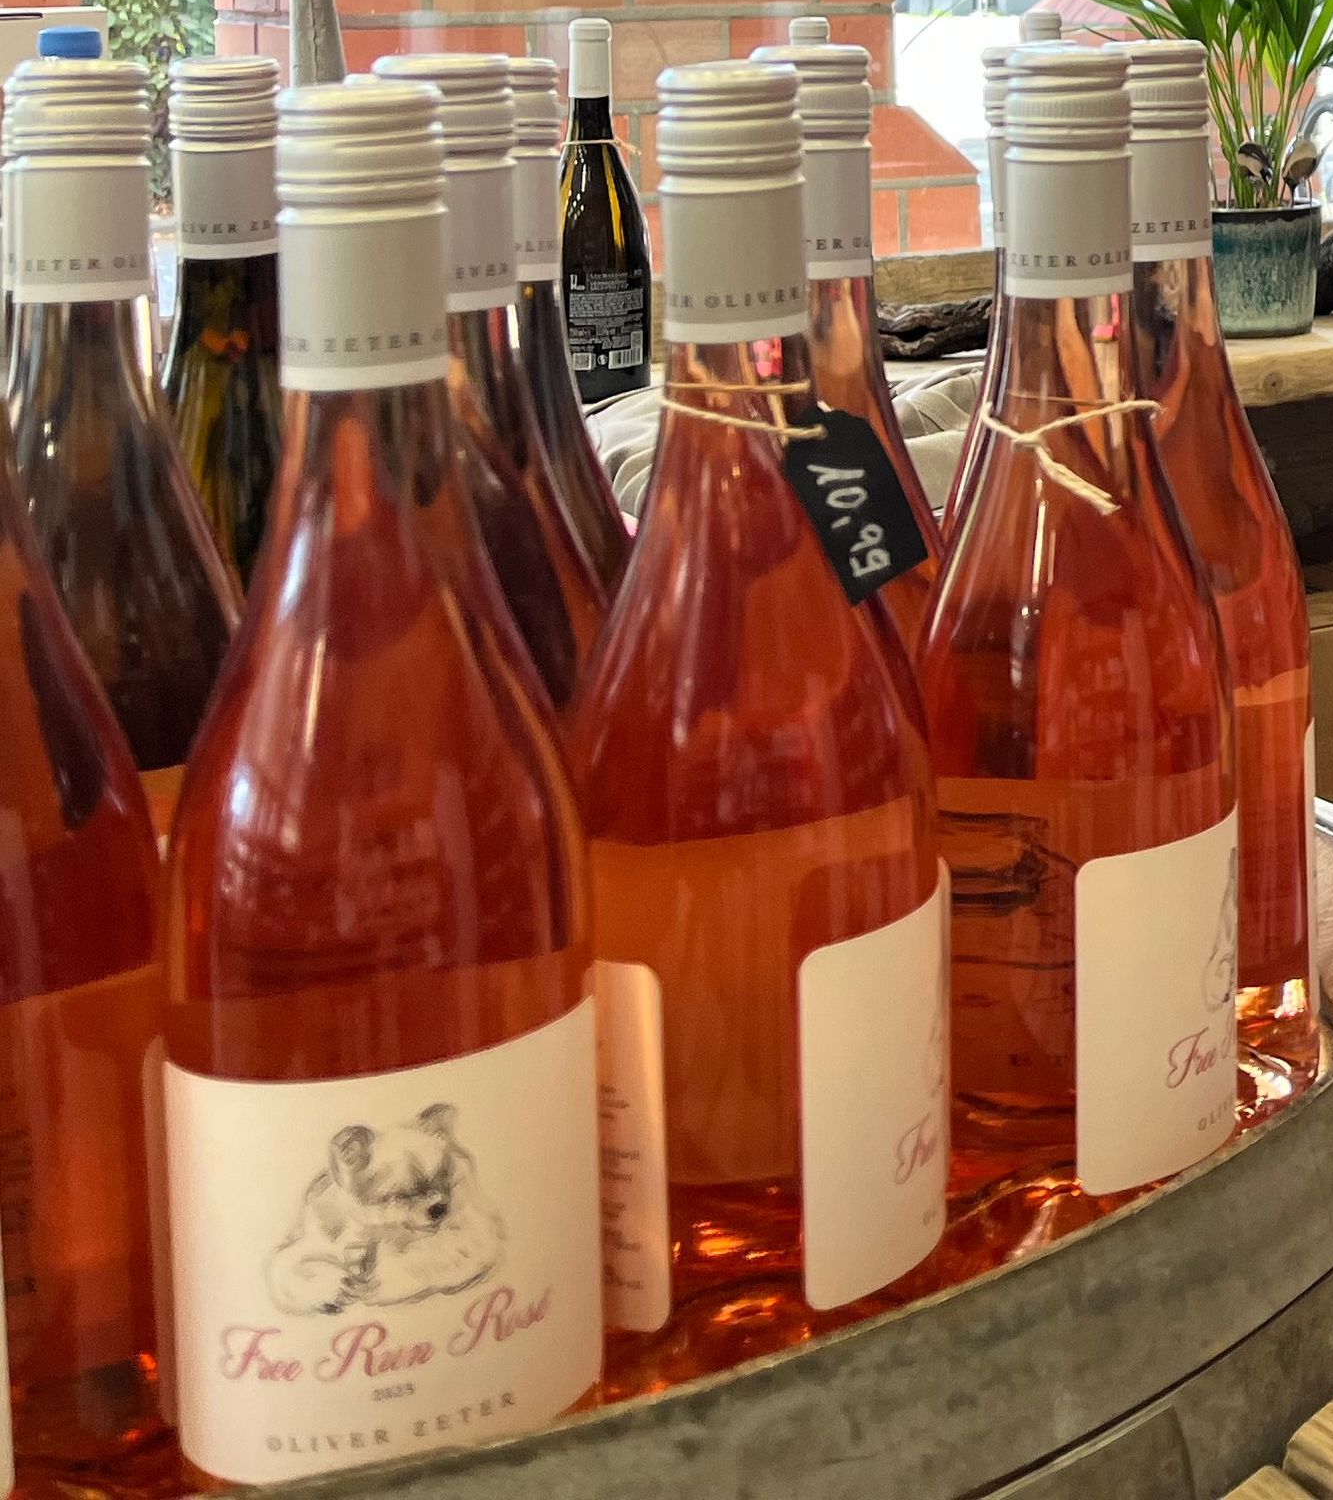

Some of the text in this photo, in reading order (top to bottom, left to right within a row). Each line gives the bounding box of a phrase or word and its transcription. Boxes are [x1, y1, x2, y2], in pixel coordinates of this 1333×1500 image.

[181, 223, 237, 234] LIVER
[1130, 218, 1197, 234] ZETER
[1010, 252, 1078, 268] ZETER
[323, 331, 423, 353] ZETER
[806, 463, 892, 578] 10,99
[220, 1325, 302, 1383] Free
[310, 1320, 436, 1383] Run
[266, 1391, 516, 1452] OLIVER ZETER
